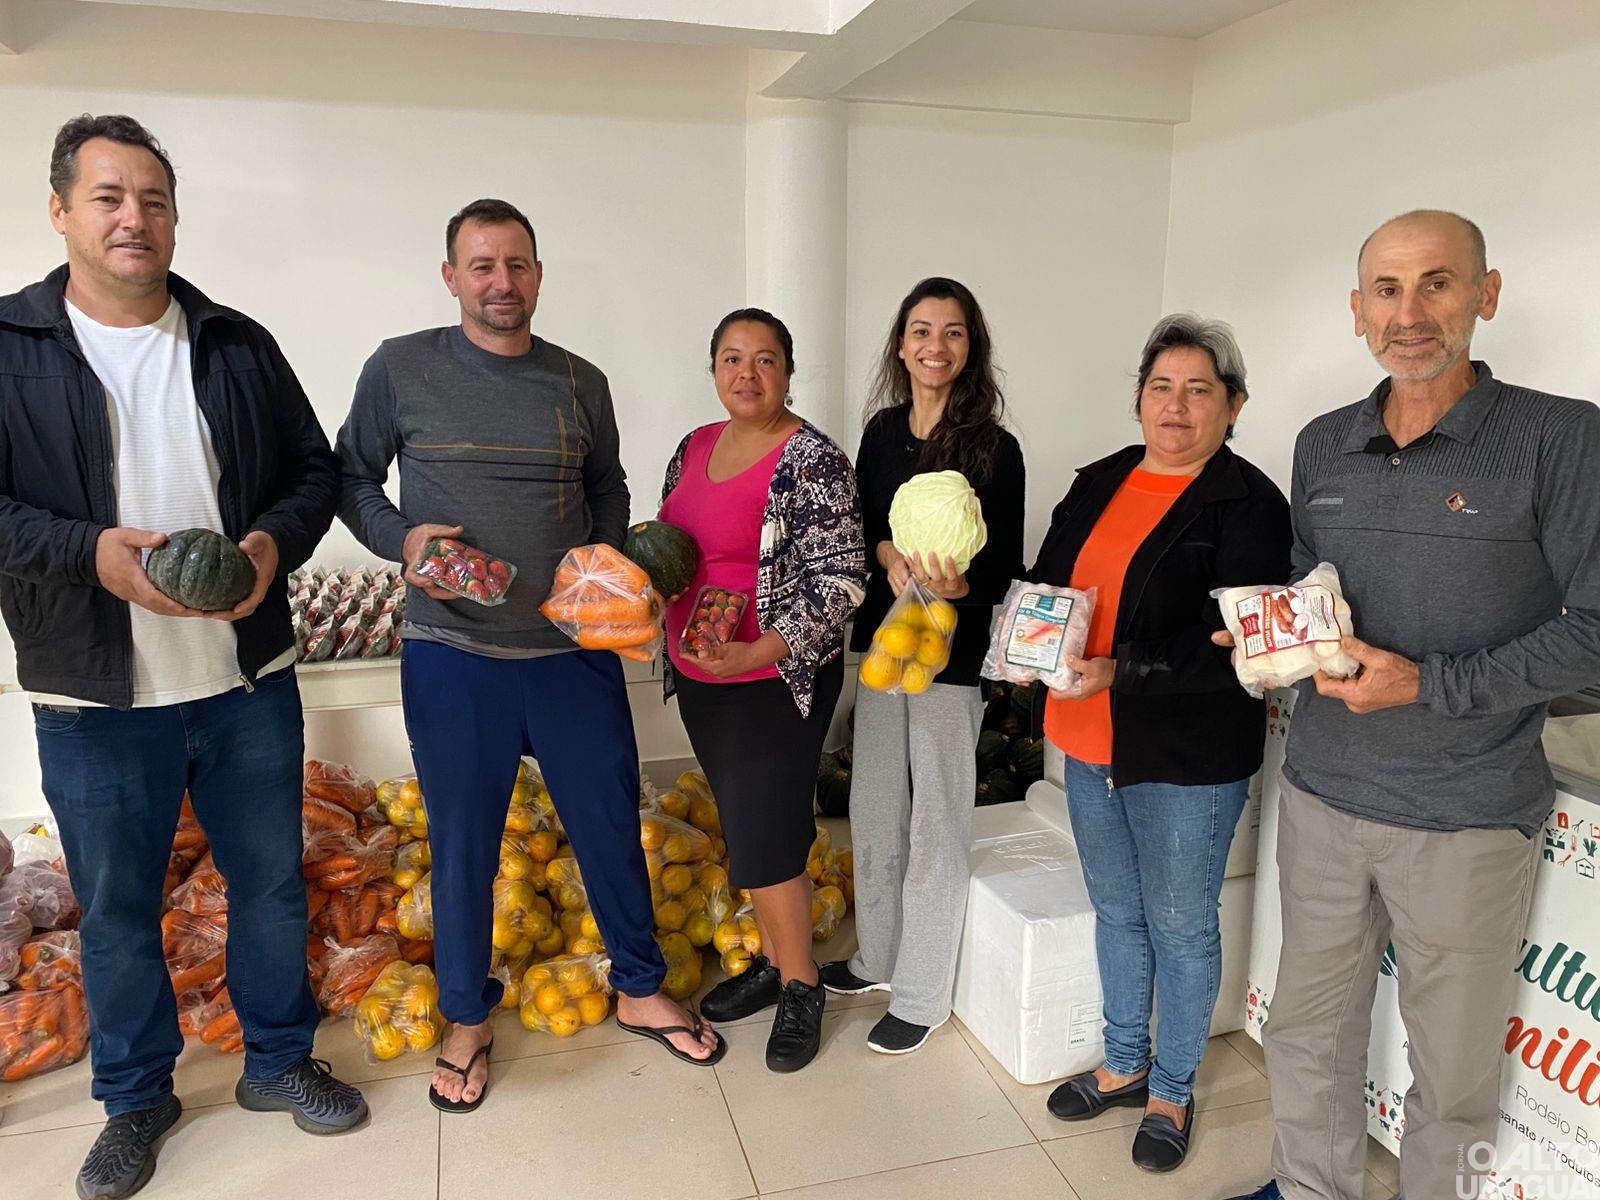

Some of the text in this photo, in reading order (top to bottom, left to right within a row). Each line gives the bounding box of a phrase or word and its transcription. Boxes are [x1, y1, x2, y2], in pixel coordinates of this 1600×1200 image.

[1515, 1084, 1600, 1157] Rodeio Bo
[1547, 1140, 1600, 1188] Produtos
